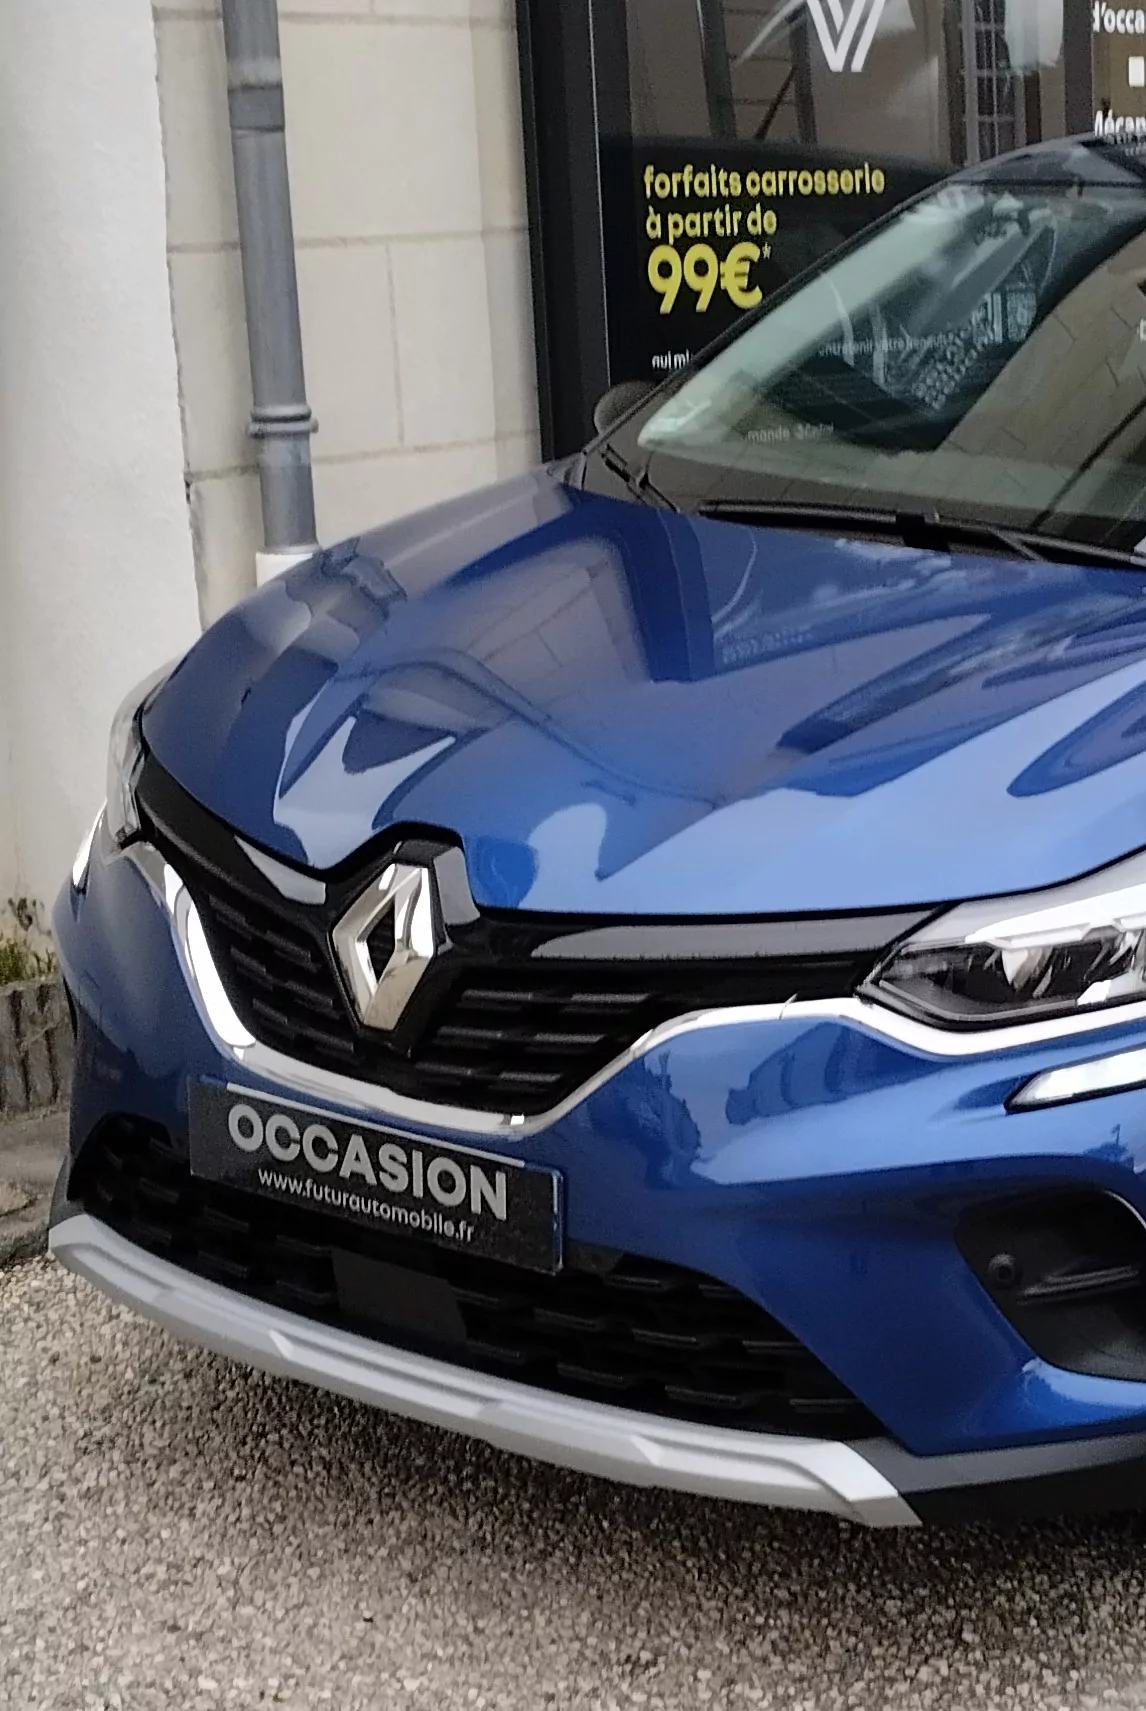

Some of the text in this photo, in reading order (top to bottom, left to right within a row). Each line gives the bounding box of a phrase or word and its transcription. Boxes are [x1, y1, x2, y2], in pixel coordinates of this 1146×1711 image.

[644, 161, 886, 199] forfaits carrosserie
[646, 202, 778, 246] à partir de
[228, 1102, 507, 1222] OCCASION
[257, 1167, 475, 1243] www.futurautomobile.fr
